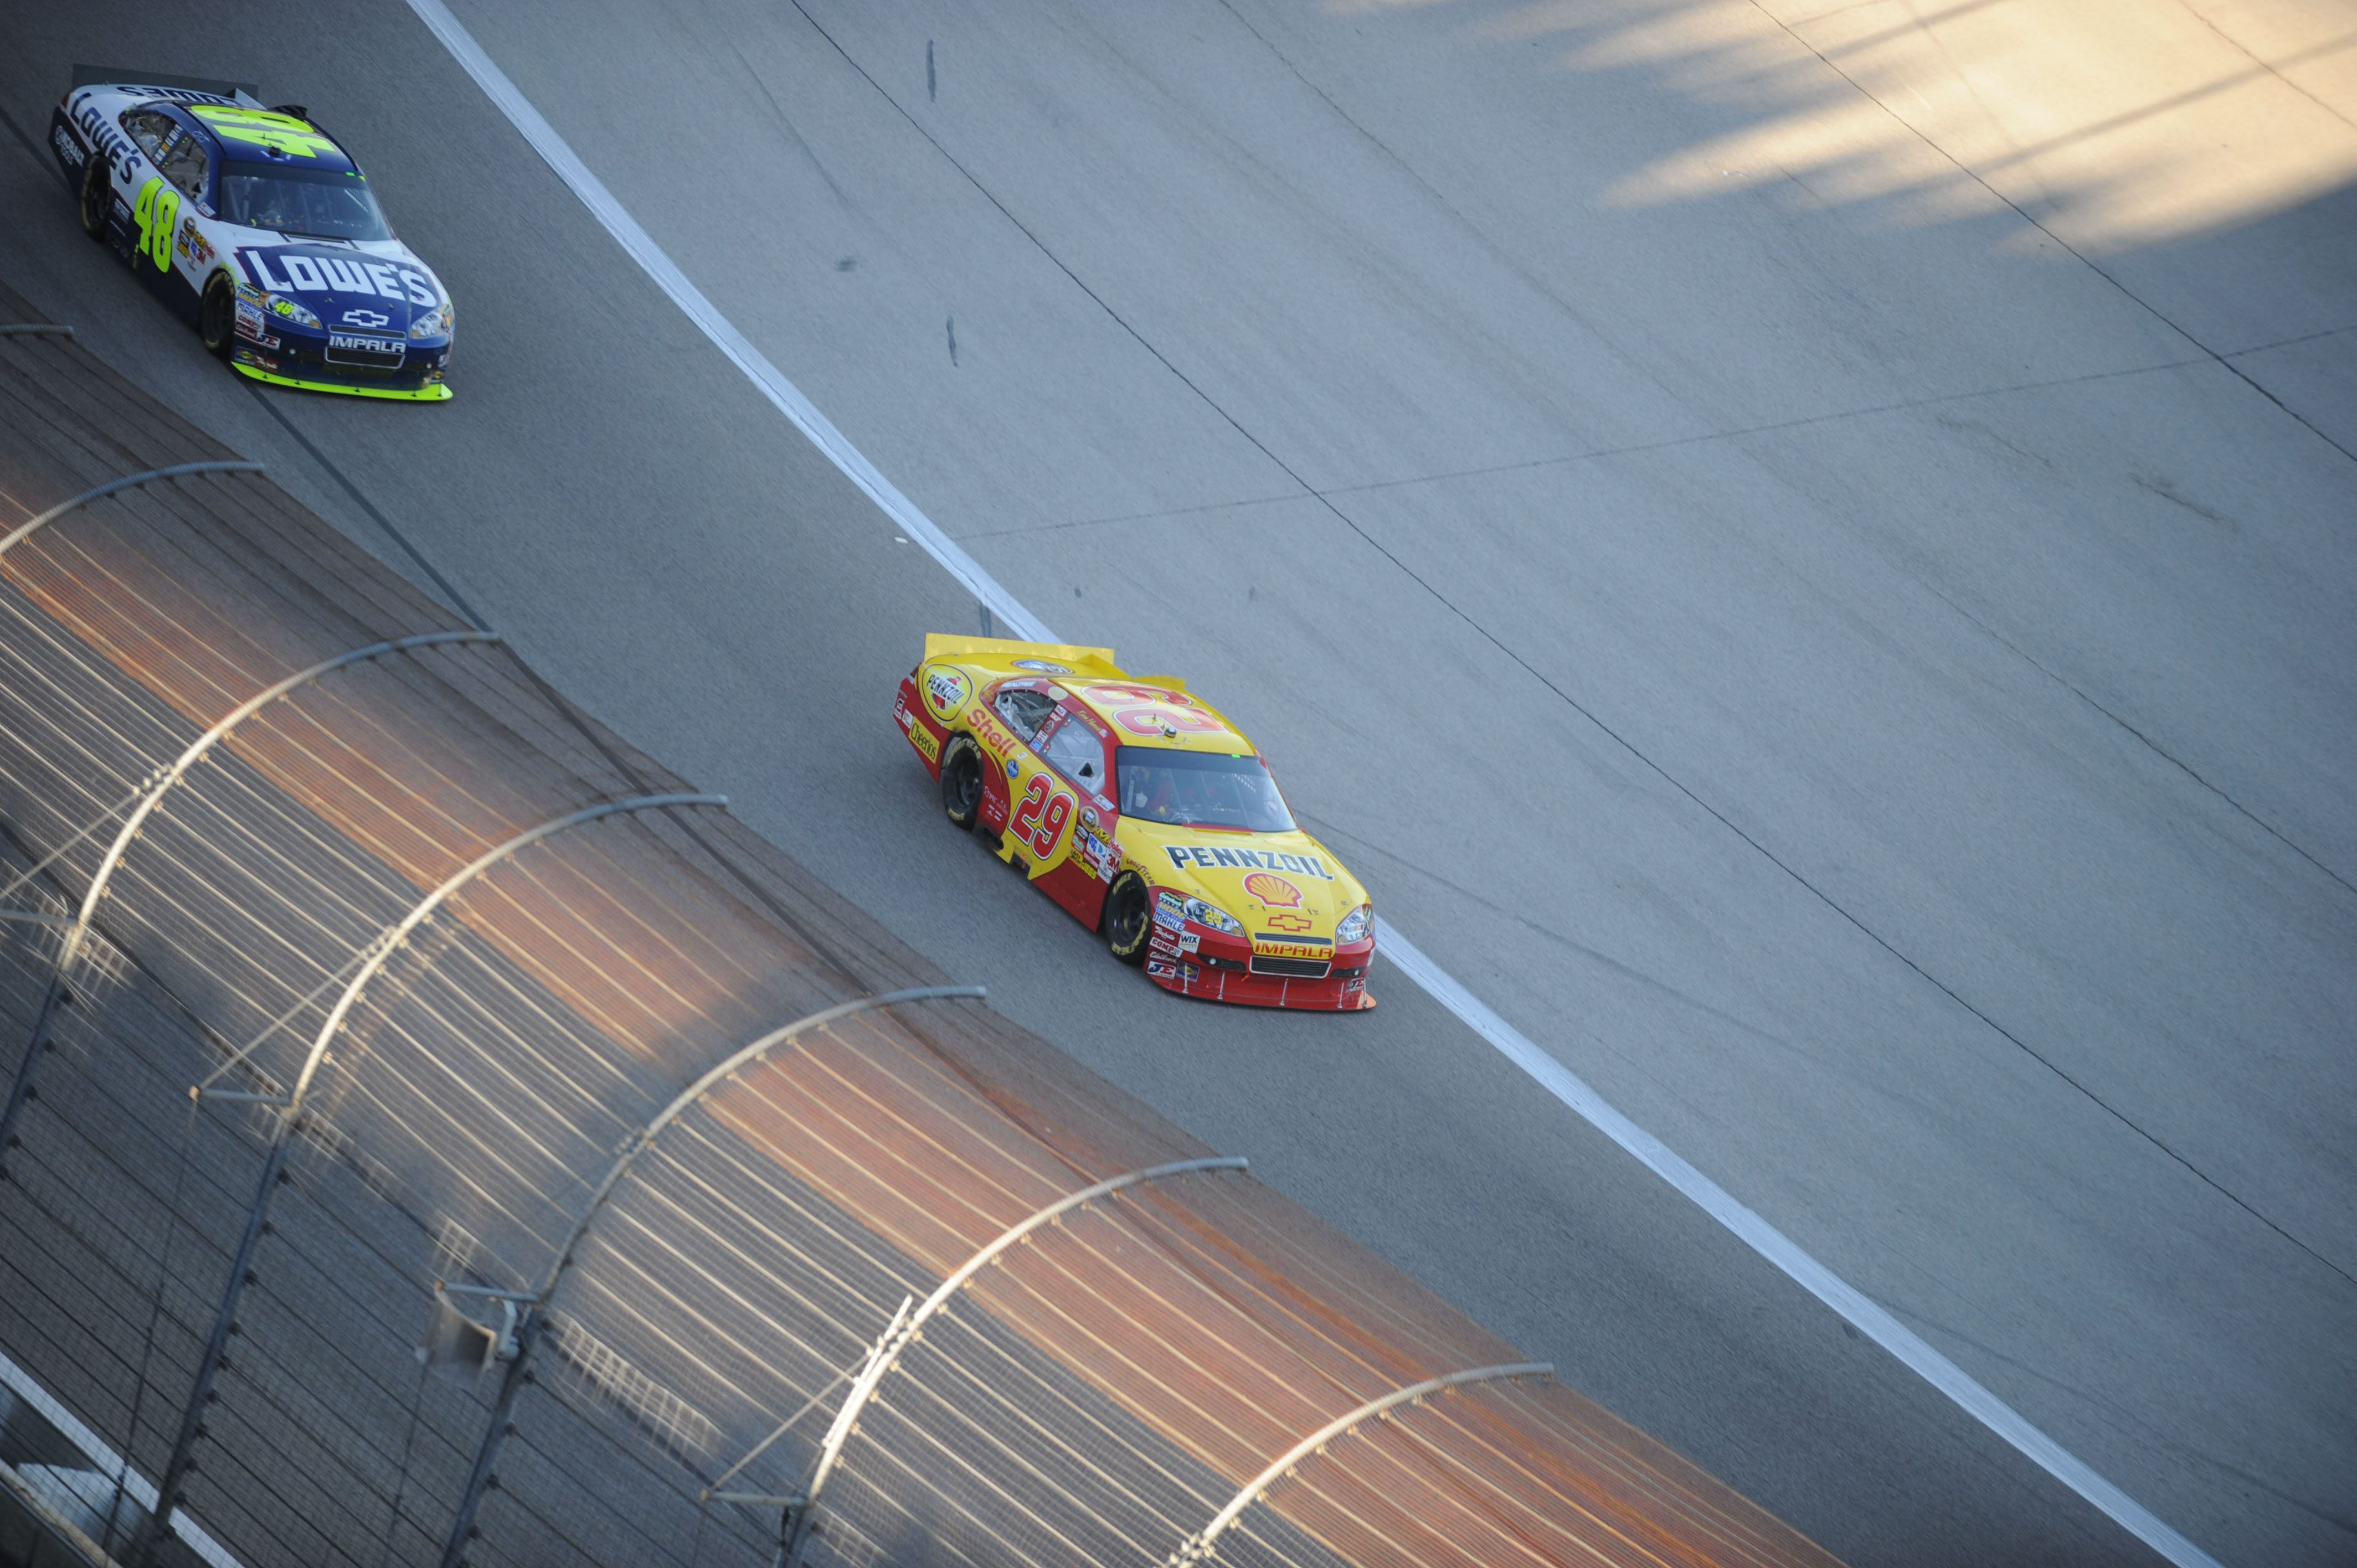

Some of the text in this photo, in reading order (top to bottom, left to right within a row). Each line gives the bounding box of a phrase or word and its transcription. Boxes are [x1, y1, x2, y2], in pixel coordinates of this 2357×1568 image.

[70, 92, 141, 184] LOWE'S
[190, 105, 336, 158] 48
[133, 176, 181, 273] 48
[246, 251, 438, 308] LOWE'S
[275, 301, 294, 316] 48
[329, 336, 408, 353] IMPALA
[926, 674, 965, 704] PENNZOIL
[1082, 685, 1231, 736] 29
[910, 723, 936, 761] Cheerios
[966, 709, 1017, 757] Shell
[1008, 773, 1075, 859] 29
[1107, 853, 1120, 873] 3M
[1161, 845, 1334, 881] PENNZOIL
[1154, 912, 1184, 932] MAHLE
[1205, 909, 1223, 925] 29
[1151, 938, 1175, 952] COMP
[1181, 935, 1198, 944] WIX
[1254, 942, 1332, 958] IMPALA
[1149, 963, 1173, 976] JE
